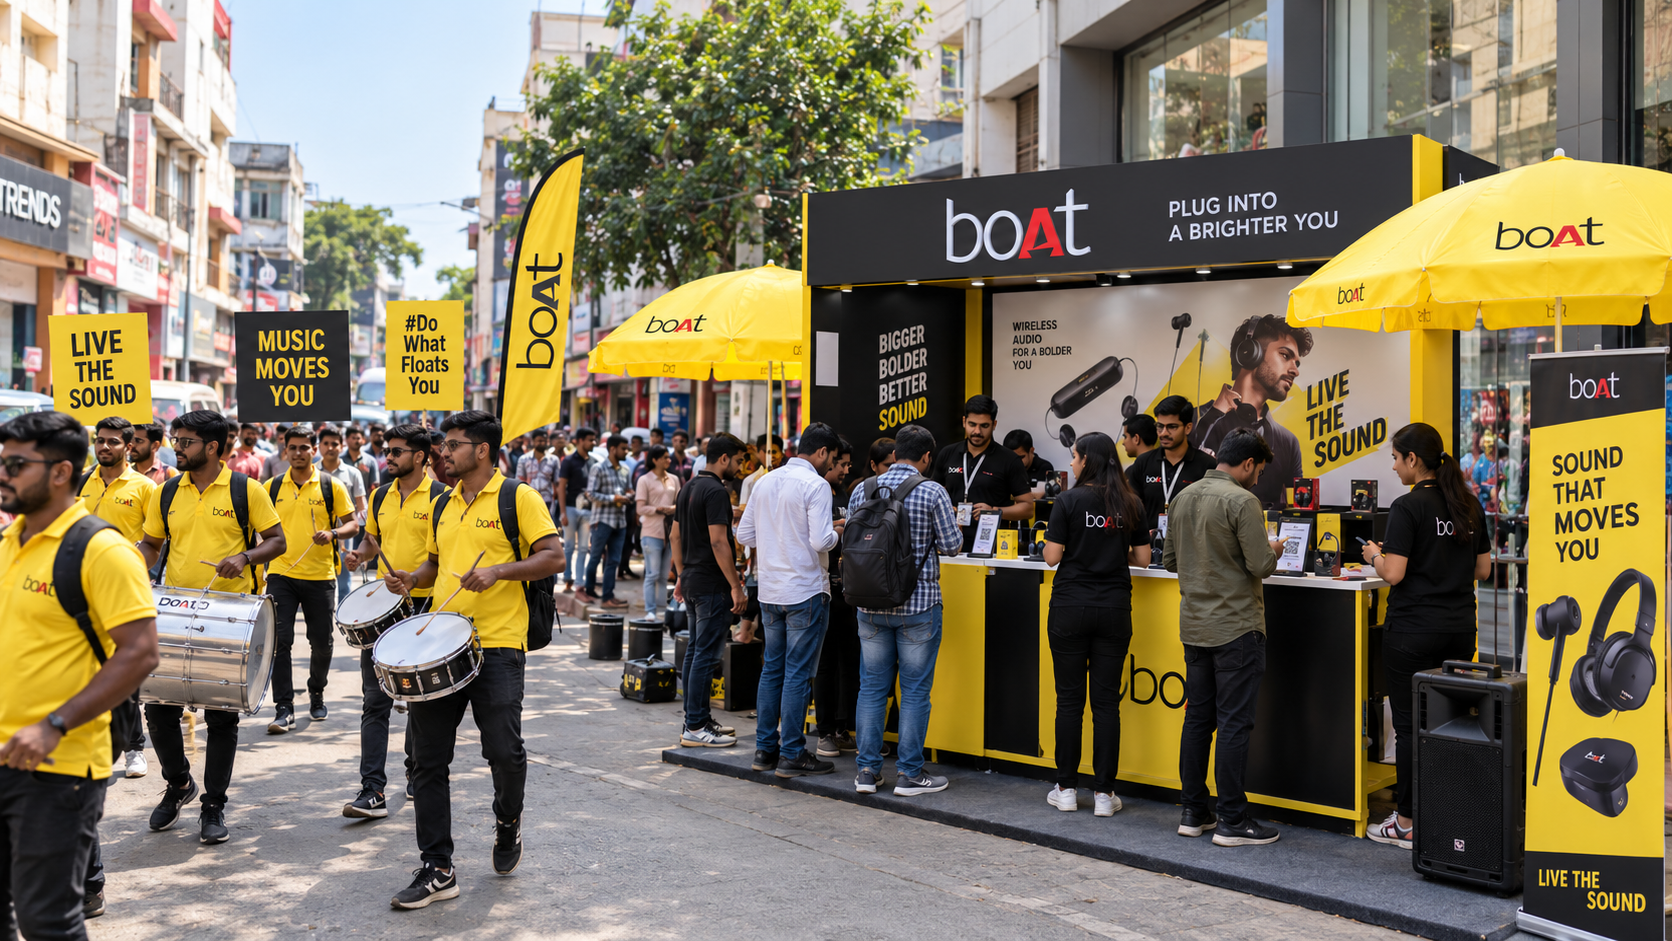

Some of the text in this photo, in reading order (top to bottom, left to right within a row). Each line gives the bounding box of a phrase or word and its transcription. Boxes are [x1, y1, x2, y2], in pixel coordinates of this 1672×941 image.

[1169, 191, 1277, 218] PLUG INTO
[1168, 210, 1338, 242] A BRIGHTER YOU
[1495, 217, 1604, 250] boAt
[406, 314, 437, 331] #Do
[645, 314, 707, 333] boAt
[1013, 320, 1057, 331] WIRELESS
[71, 330, 122, 357] LIVE
[258, 329, 325, 351] MUSIC
[404, 335, 446, 352] What
[879, 325, 924, 354] BIGGER
[1013, 334, 1042, 345] AUDIO
[1013, 346, 1072, 357] FOR A BOLDER
[75, 359, 114, 382] THE
[256, 357, 330, 379] MOVES
[402, 356, 449, 373] Floats
[879, 348, 927, 379] BOLDER
[1013, 360, 1032, 370] YOU
[70, 384, 136, 409] SOUND
[270, 385, 314, 406] YOU
[409, 376, 440, 394] You
[879, 372, 927, 405] BETTER
[1307, 369, 1349, 410] LIVE
[1570, 372, 1620, 399] boAt
[879, 397, 927, 430] SOUND
[1306, 403, 1344, 440] THE
[1314, 418, 1386, 468] SOUND
[1552, 446, 1623, 476] SOUND
[1553, 477, 1605, 504] THAT
[1555, 502, 1639, 535] MOVES
[1555, 538, 1599, 563] YOU
[1539, 869, 1600, 889] LIVE THE
[1587, 891, 1646, 912] SOUND
